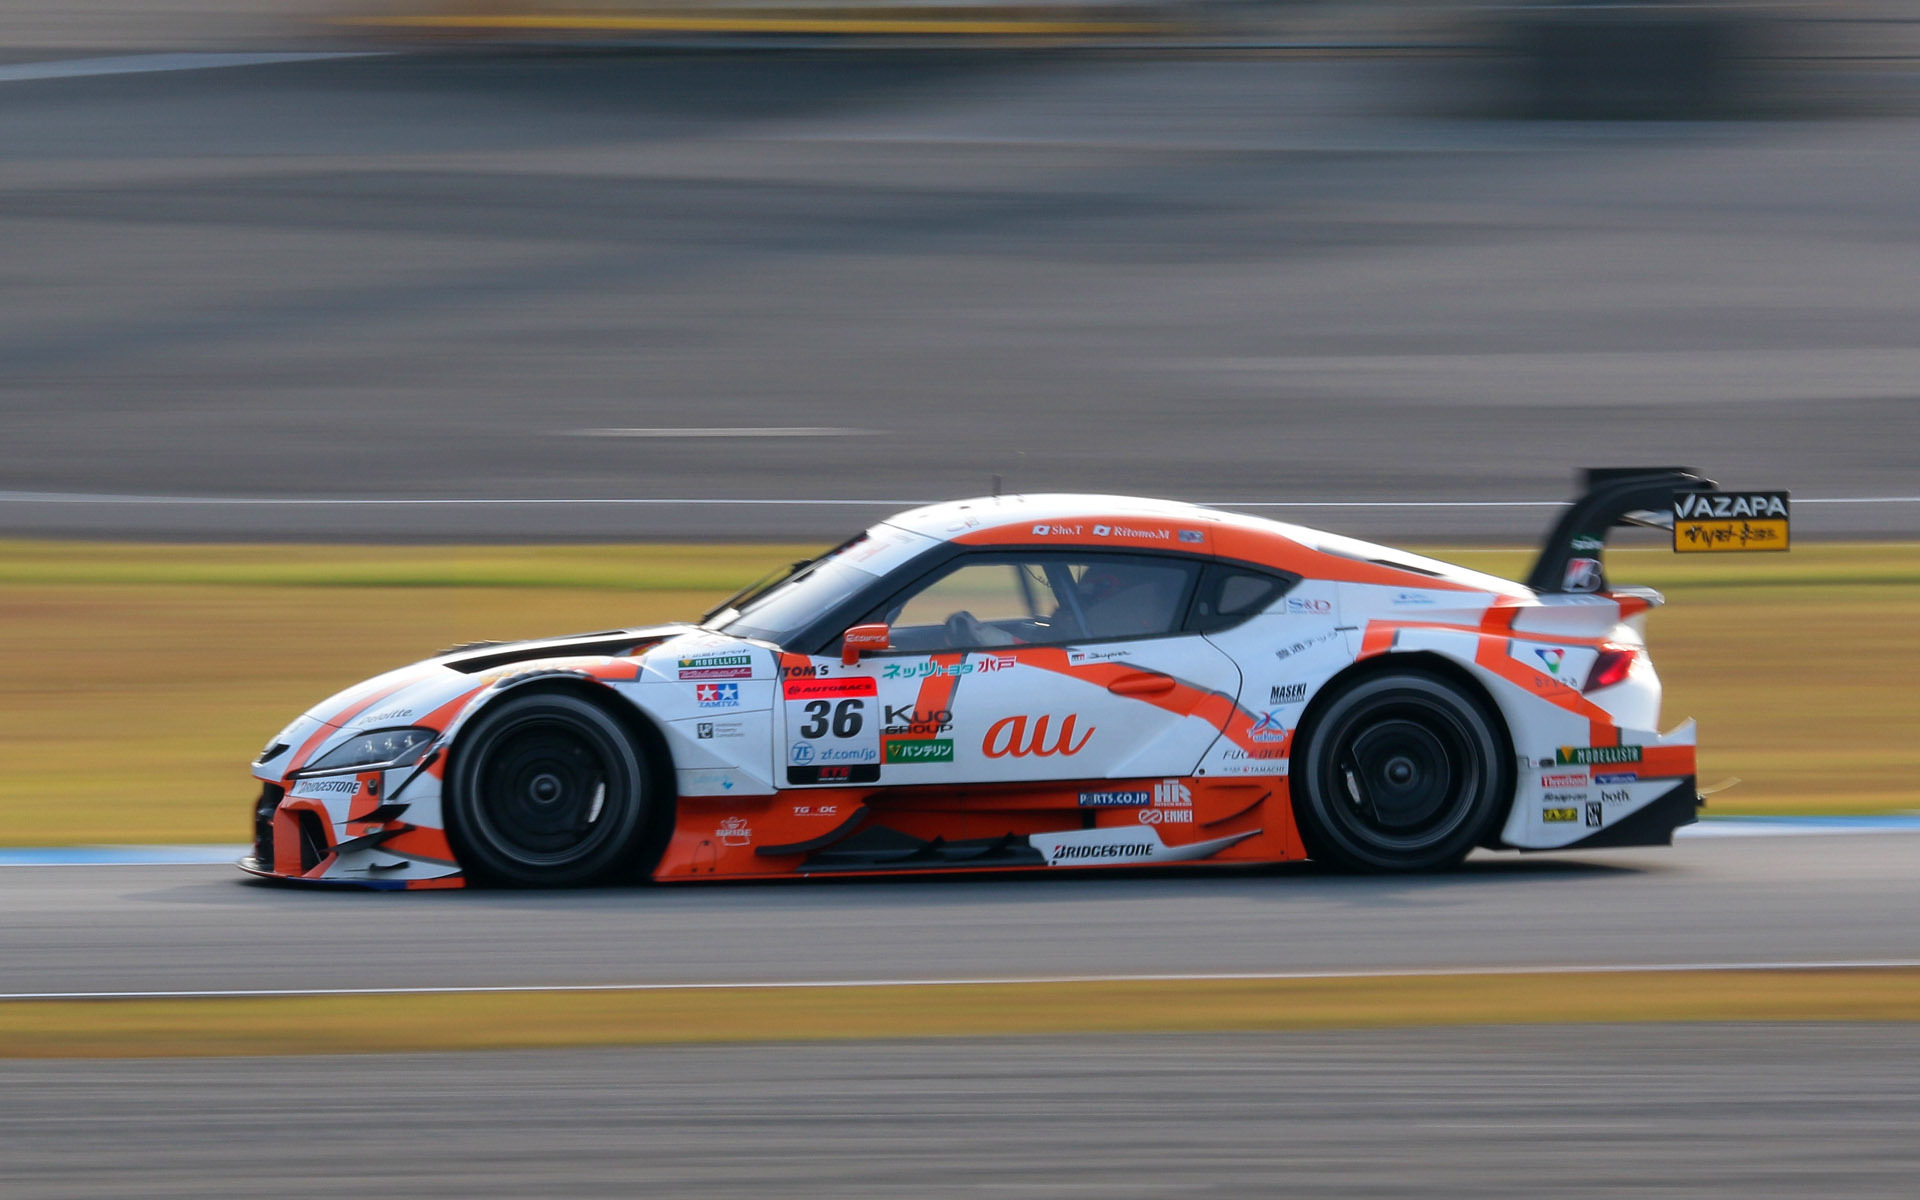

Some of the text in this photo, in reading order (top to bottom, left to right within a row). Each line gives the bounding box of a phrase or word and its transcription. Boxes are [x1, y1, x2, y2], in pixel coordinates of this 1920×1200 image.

[1692, 495, 1789, 518] AZAPA
[1052, 524, 1084, 535] Sho.T
[1288, 597, 1332, 611] S&D
[695, 656, 748, 667] MODELLISTA
[783, 663, 830, 678] TOM'S
[801, 683, 873, 693] AUTOBACS
[1270, 683, 1307, 700] MASEKI
[699, 700, 740, 708] TAMIYA
[800, 698, 865, 739] 36
[885, 724, 953, 735] GROUP
[981, 712, 1097, 760] au
[820, 746, 877, 761] zf.com/jp
[1577, 747, 1640, 764] MODELLISTA
[298, 781, 362, 795] BRIDGESTONE
[1163, 809, 1193, 823] ENKEI
[1052, 843, 1155, 859] BRIDGESTONE
